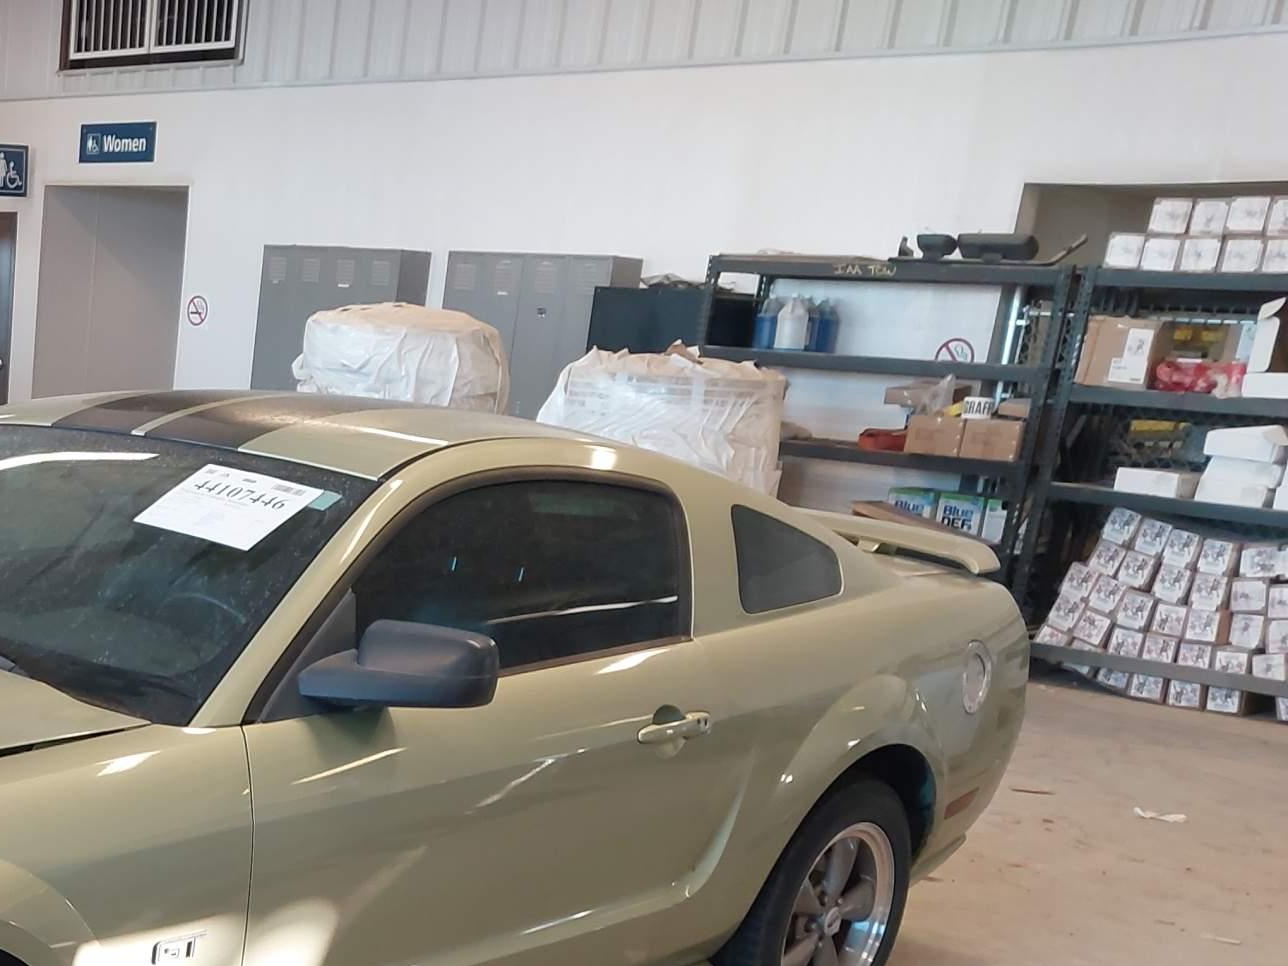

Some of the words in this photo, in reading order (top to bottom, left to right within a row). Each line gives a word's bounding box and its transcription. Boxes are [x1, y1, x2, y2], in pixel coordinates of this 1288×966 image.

[103, 134, 147, 153] Women
[194, 480, 288, 510] 44107446
[943, 504, 974, 517] Blue
